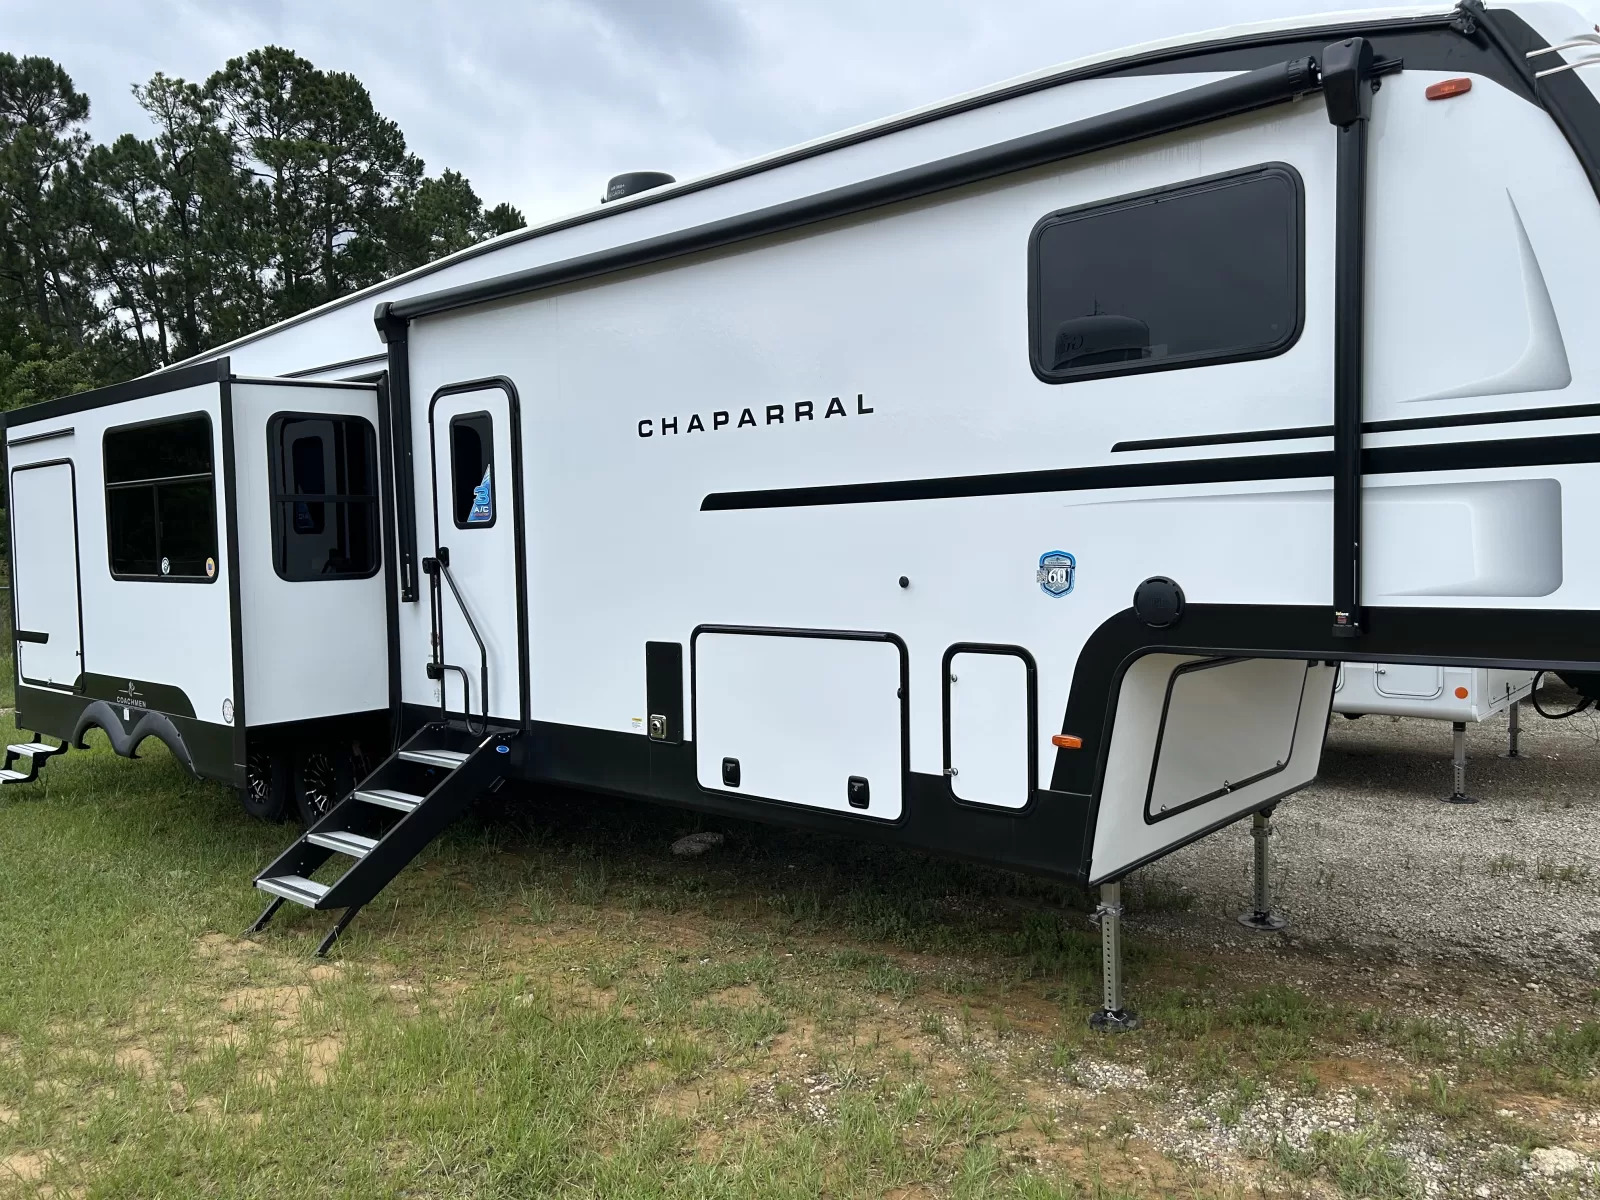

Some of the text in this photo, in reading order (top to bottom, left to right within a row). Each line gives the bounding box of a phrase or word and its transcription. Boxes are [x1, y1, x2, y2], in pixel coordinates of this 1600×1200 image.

[638, 394, 874, 437] CHAPARRAL
[473, 485, 489, 505] 3
[1048, 568, 1067, 583] 60
[116, 696, 147, 708] COACHMEN
